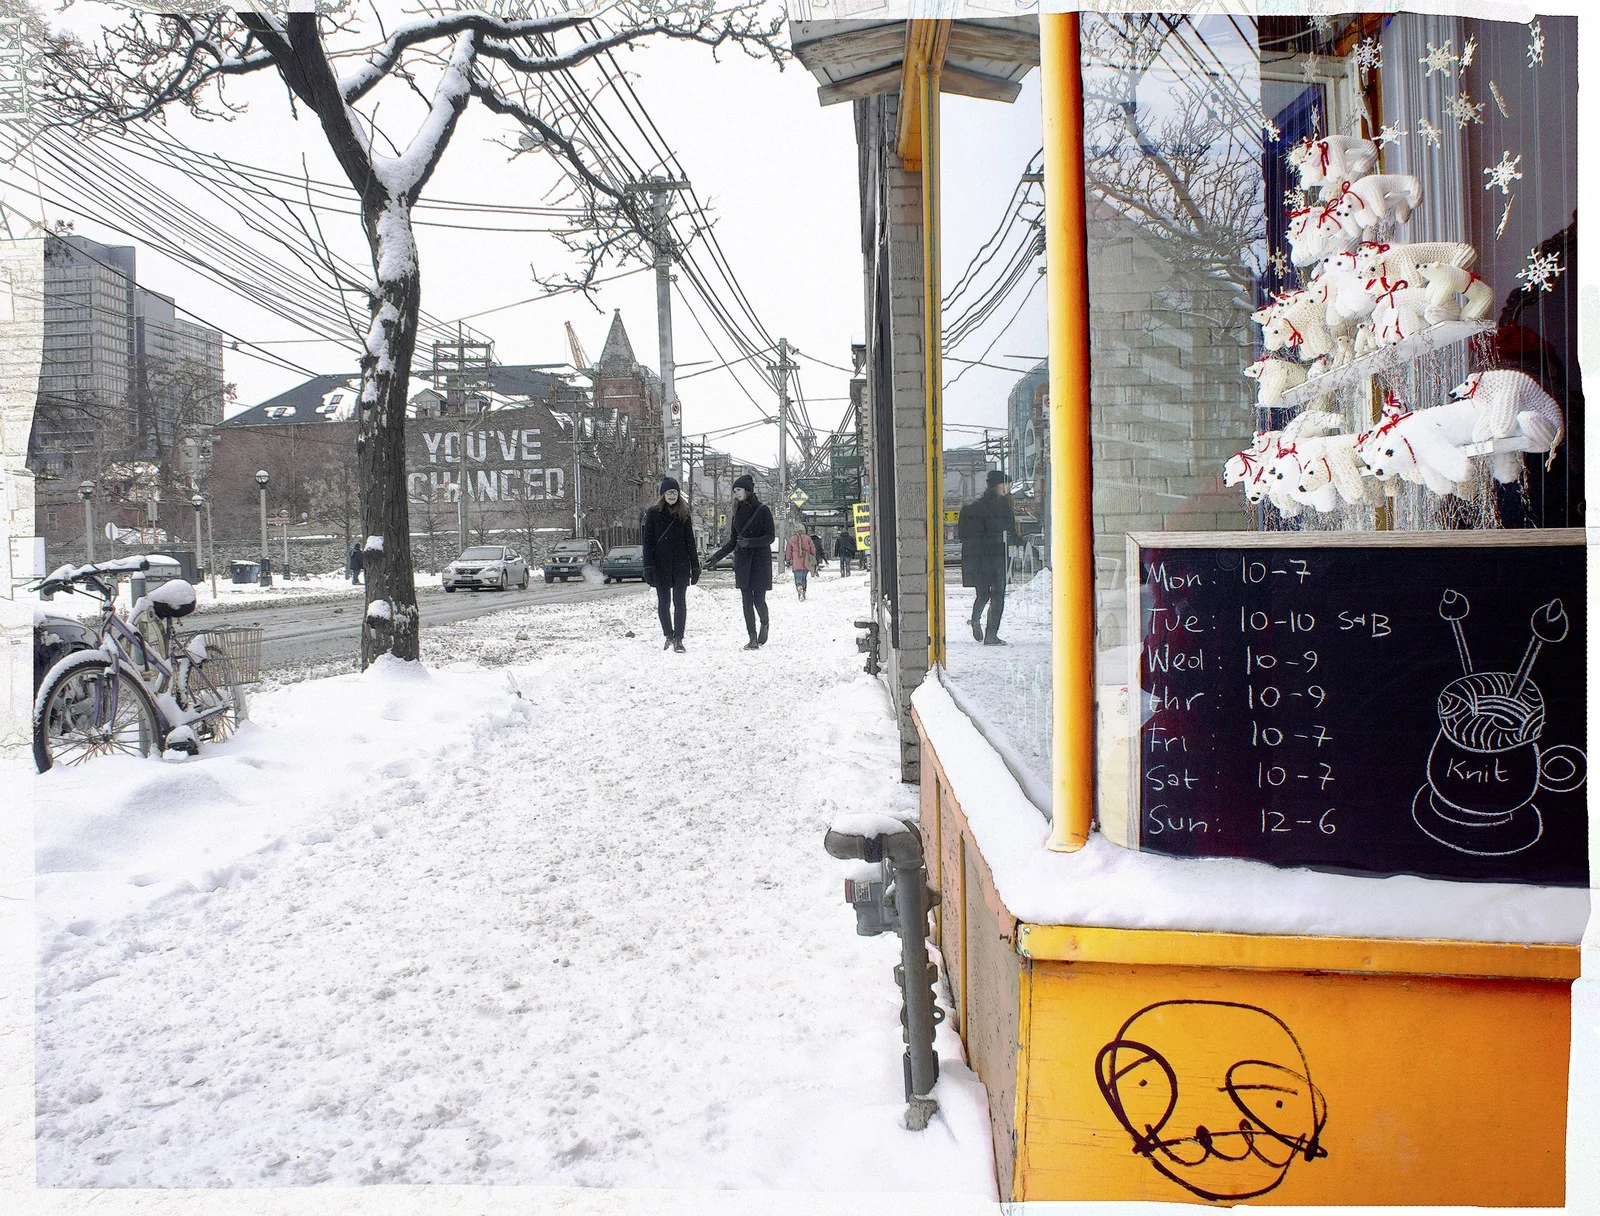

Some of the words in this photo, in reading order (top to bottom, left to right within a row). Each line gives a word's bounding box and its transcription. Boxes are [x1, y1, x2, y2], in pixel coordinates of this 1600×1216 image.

[423, 428, 541, 463] YOU'VE
[408, 467, 565, 504] CHANGED
[1242, 556, 1311, 584] 10-7
[1241, 606, 1315, 632] 10-10
[1246, 646, 1317, 674] 10-9
[1249, 684, 1326, 709] 10-9
[1252, 720, 1333, 747] 10-7
[1258, 762, 1335, 790] 10-7
[1447, 758, 1509, 782] Knit
[1261, 808, 1335, 834] 12-6
